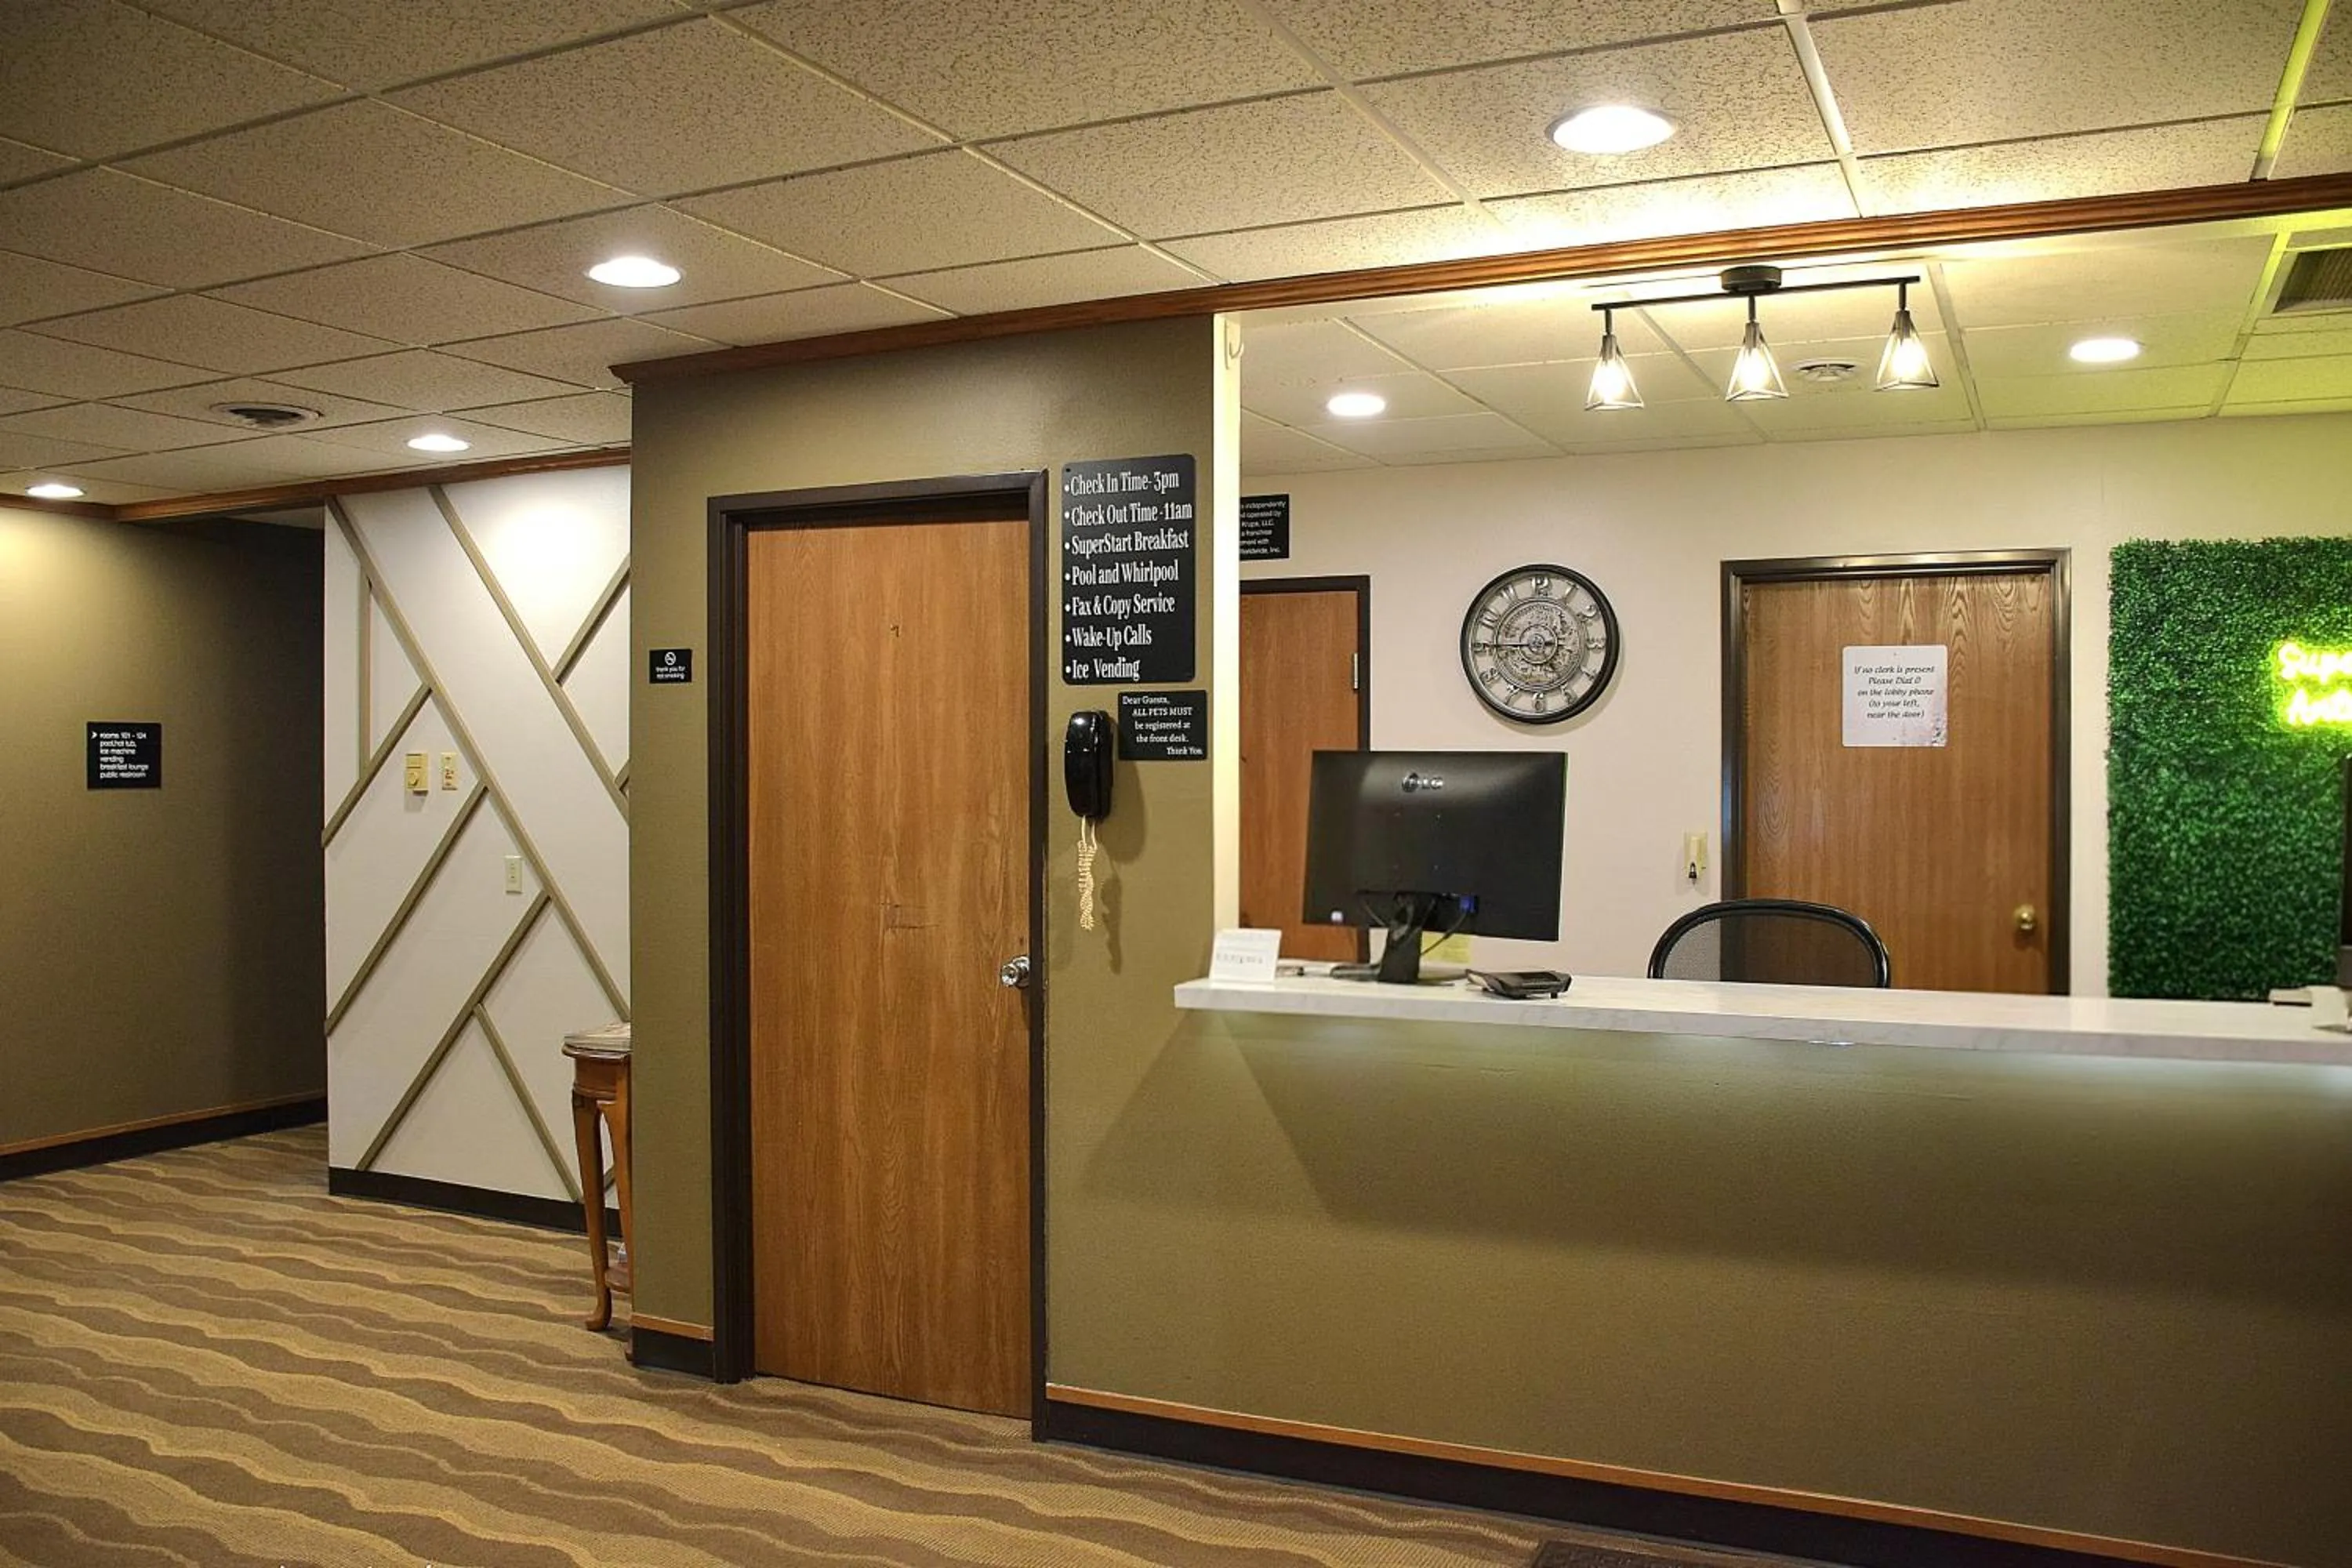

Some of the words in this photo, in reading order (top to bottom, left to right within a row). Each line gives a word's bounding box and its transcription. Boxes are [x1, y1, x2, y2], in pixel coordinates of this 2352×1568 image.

[1070, 474, 1104, 496] Check
[1107, 473, 1118, 493] In
[1154, 471, 1179, 494] 3pm
[1072, 504, 1105, 526] Check
[1107, 504, 1127, 524] Out
[1129, 502, 1157, 523] Time
[1072, 533, 1132, 559] SuperStart
[1135, 528, 1189, 551] Breakfast
[1072, 564, 1096, 586] Pool
[1099, 562, 1119, 584] and
[1121, 559, 1178, 586] Whirlpool
[1072, 597, 1092, 616] Fax
[1093, 596, 1101, 615] &
[1103, 595, 1131, 620] Copy
[1133, 592, 1175, 613] Service
[1072, 625, 1122, 651] Wake-Up
[1124, 624, 1152, 645] Calls
[1072, 659, 1088, 679] Ice
[1094, 657, 1140, 681] Vending
[1905, 666, 1935, 674] present
[1885, 689, 1906, 697] lobby
[1909, 689, 1934, 697] phone
[1122, 696, 1141, 704] Dear
[1132, 708, 1148, 717] ALL
[1169, 707, 1192, 716] MUST
[1135, 721, 1144, 730] be
[1145, 720, 1181, 731] registered
[1136, 734, 1148, 742] the
[1149, 734, 1168, 742] front
[1169, 734, 1189, 742] desk.
[1167, 747, 1187, 755] Thank
[100, 755, 124, 764] vending
[1422, 777, 1444, 790] LG
